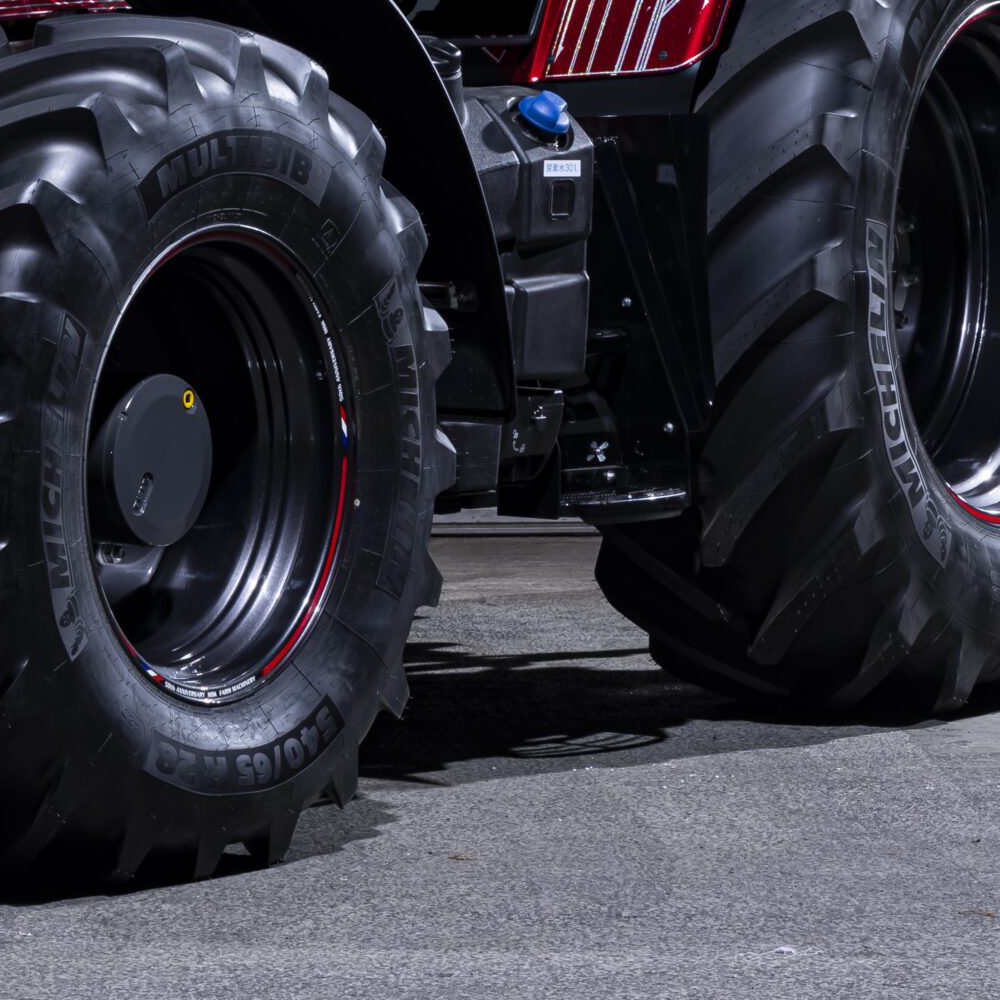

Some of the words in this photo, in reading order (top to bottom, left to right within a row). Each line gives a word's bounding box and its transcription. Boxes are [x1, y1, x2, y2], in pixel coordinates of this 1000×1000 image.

[156, 135, 313, 199] MULTIBIB
[866, 223, 927, 509] MICHELIN
[42, 316, 82, 589] MICHELIN
[155, 741, 196, 785] 28
[203, 756, 227, 781] R
[235, 705, 335, 786] 540/65
